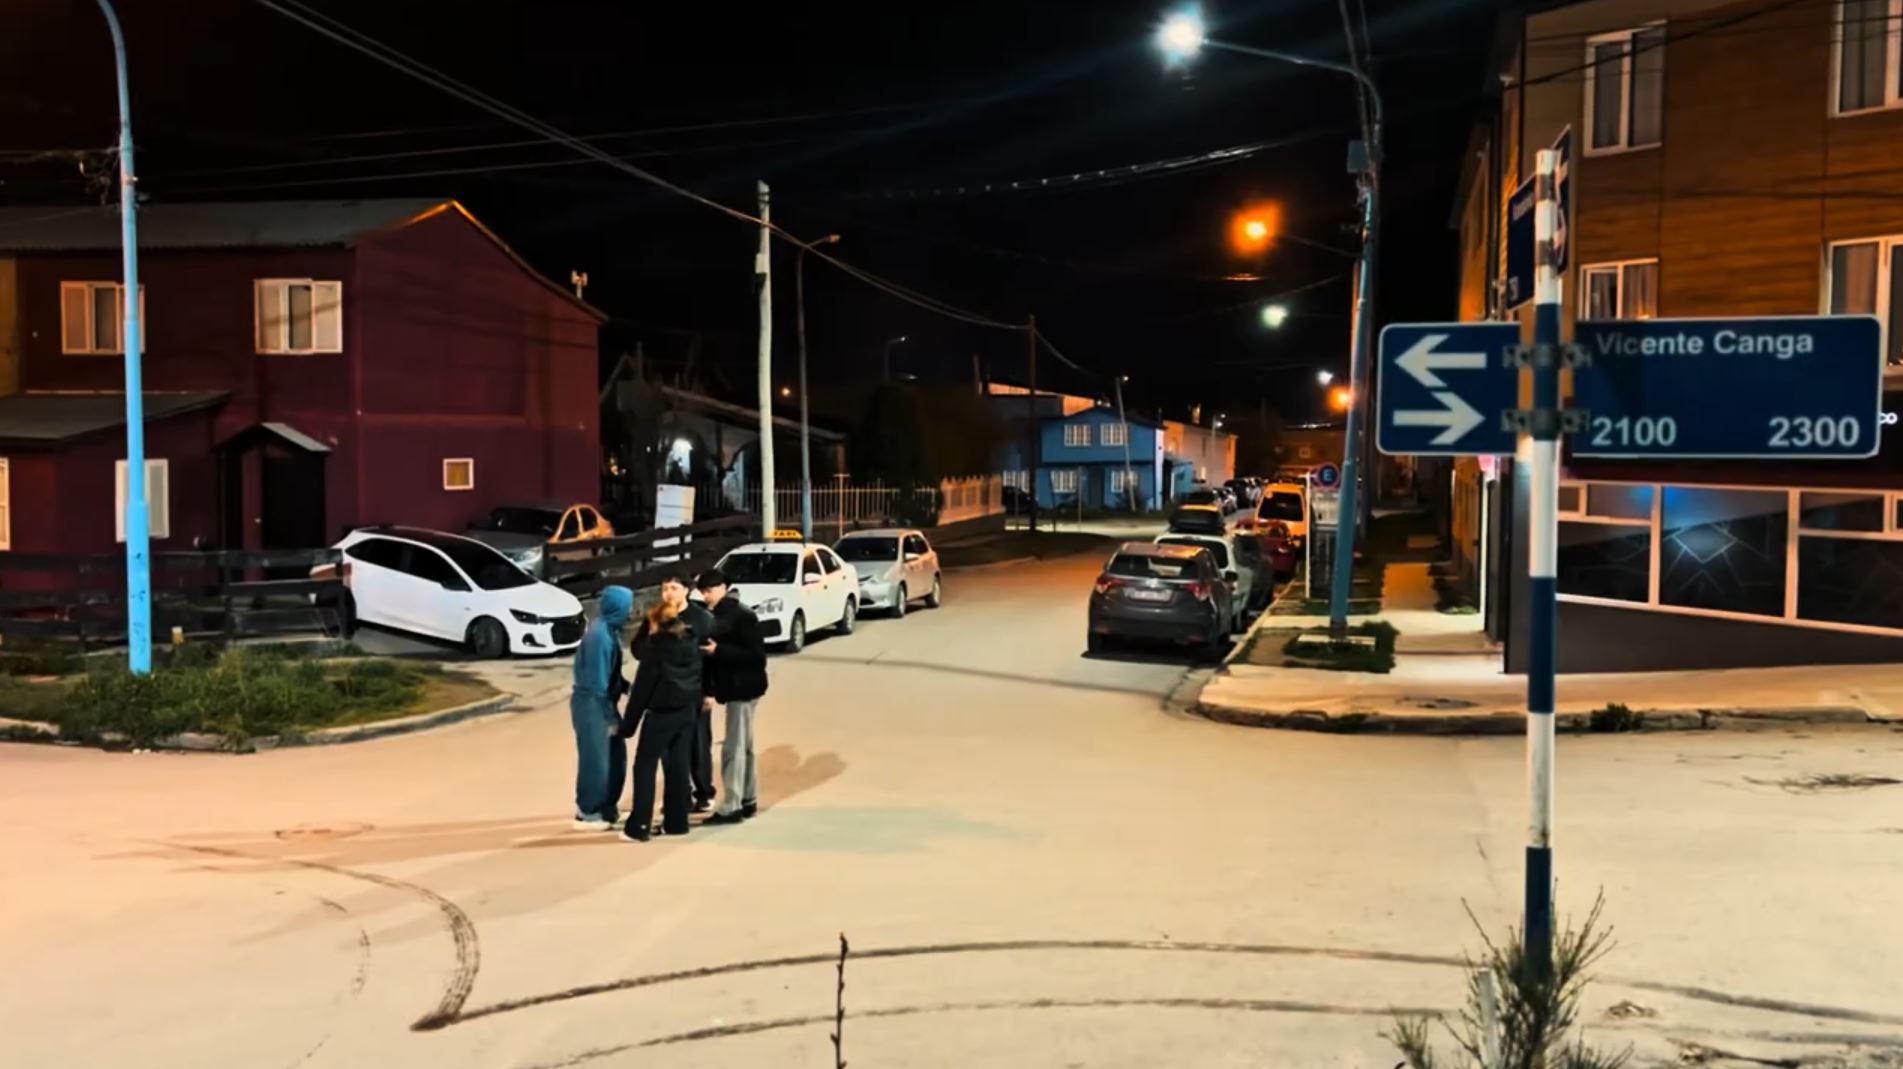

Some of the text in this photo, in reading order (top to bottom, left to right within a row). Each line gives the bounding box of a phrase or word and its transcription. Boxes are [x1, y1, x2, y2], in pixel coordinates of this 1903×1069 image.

[1595, 329, 1814, 360] Vicente Canga
[1591, 415, 1860, 447] 2100 2300
